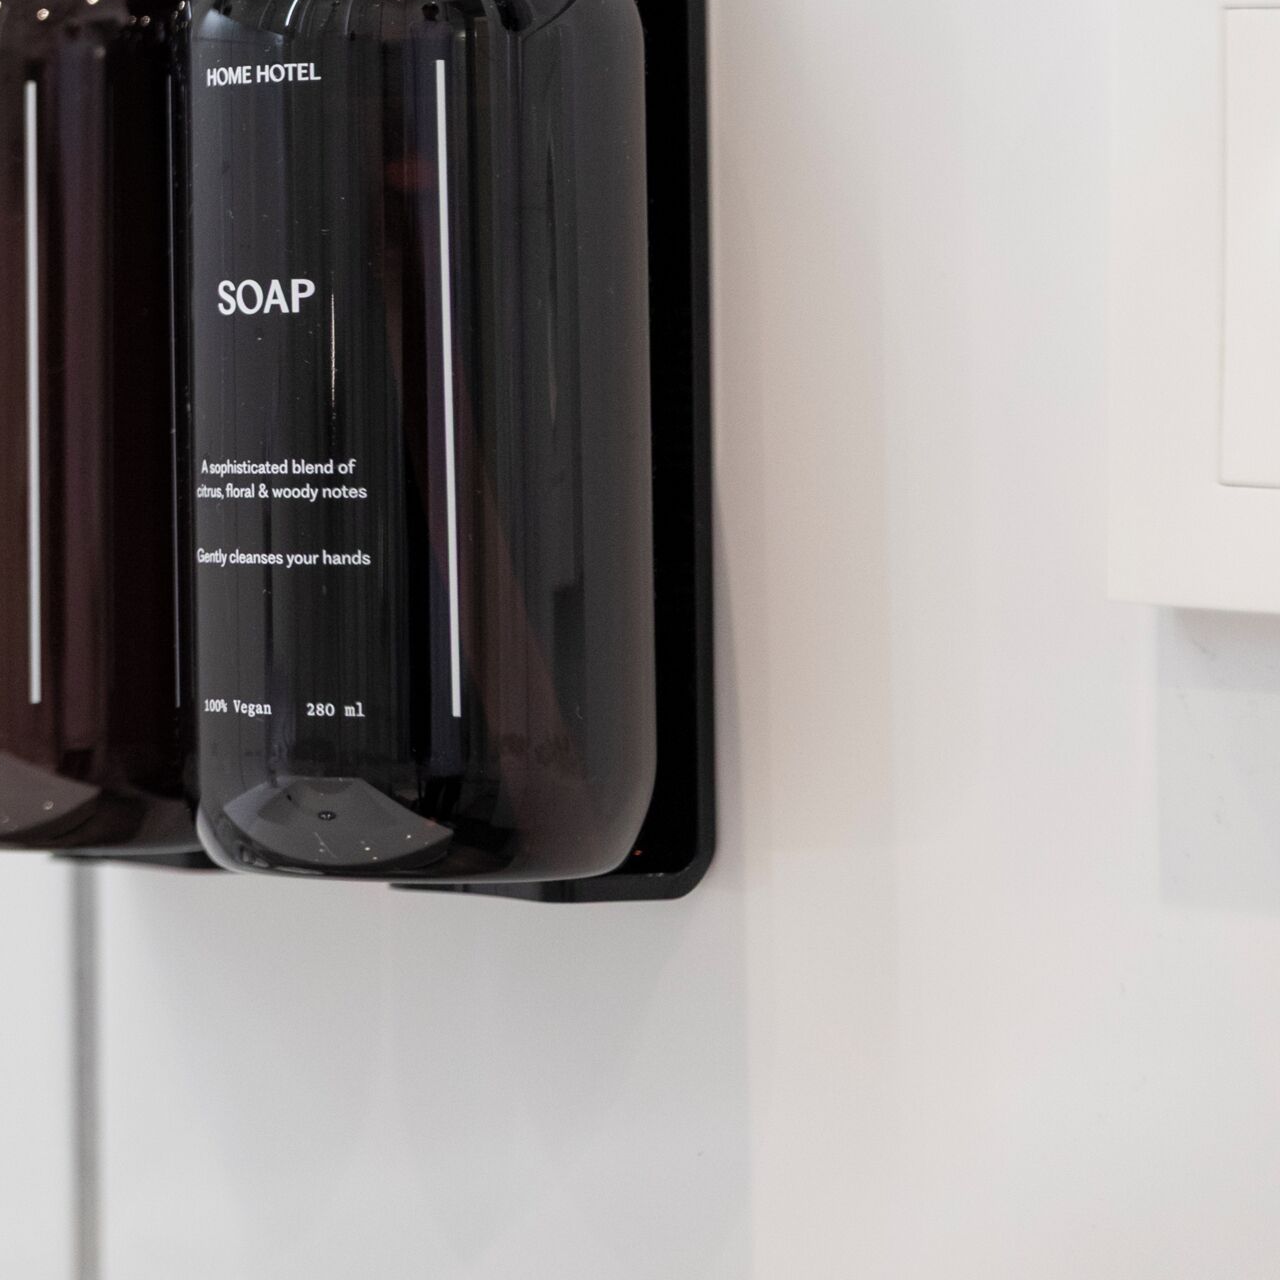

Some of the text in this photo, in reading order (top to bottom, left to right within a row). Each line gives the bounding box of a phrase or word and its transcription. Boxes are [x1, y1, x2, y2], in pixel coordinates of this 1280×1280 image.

[206, 62, 322, 87] HOME HOTEL
[217, 277, 316, 316] SOAP
[201, 458, 358, 478] A sophisticated blend of
[196, 482, 368, 503] citrus, floral & woody notes
[196, 547, 372, 569] Gently cleanses your hands
[204, 698, 272, 718] 100% Vegan
[306, 701, 366, 718] 280 ml
